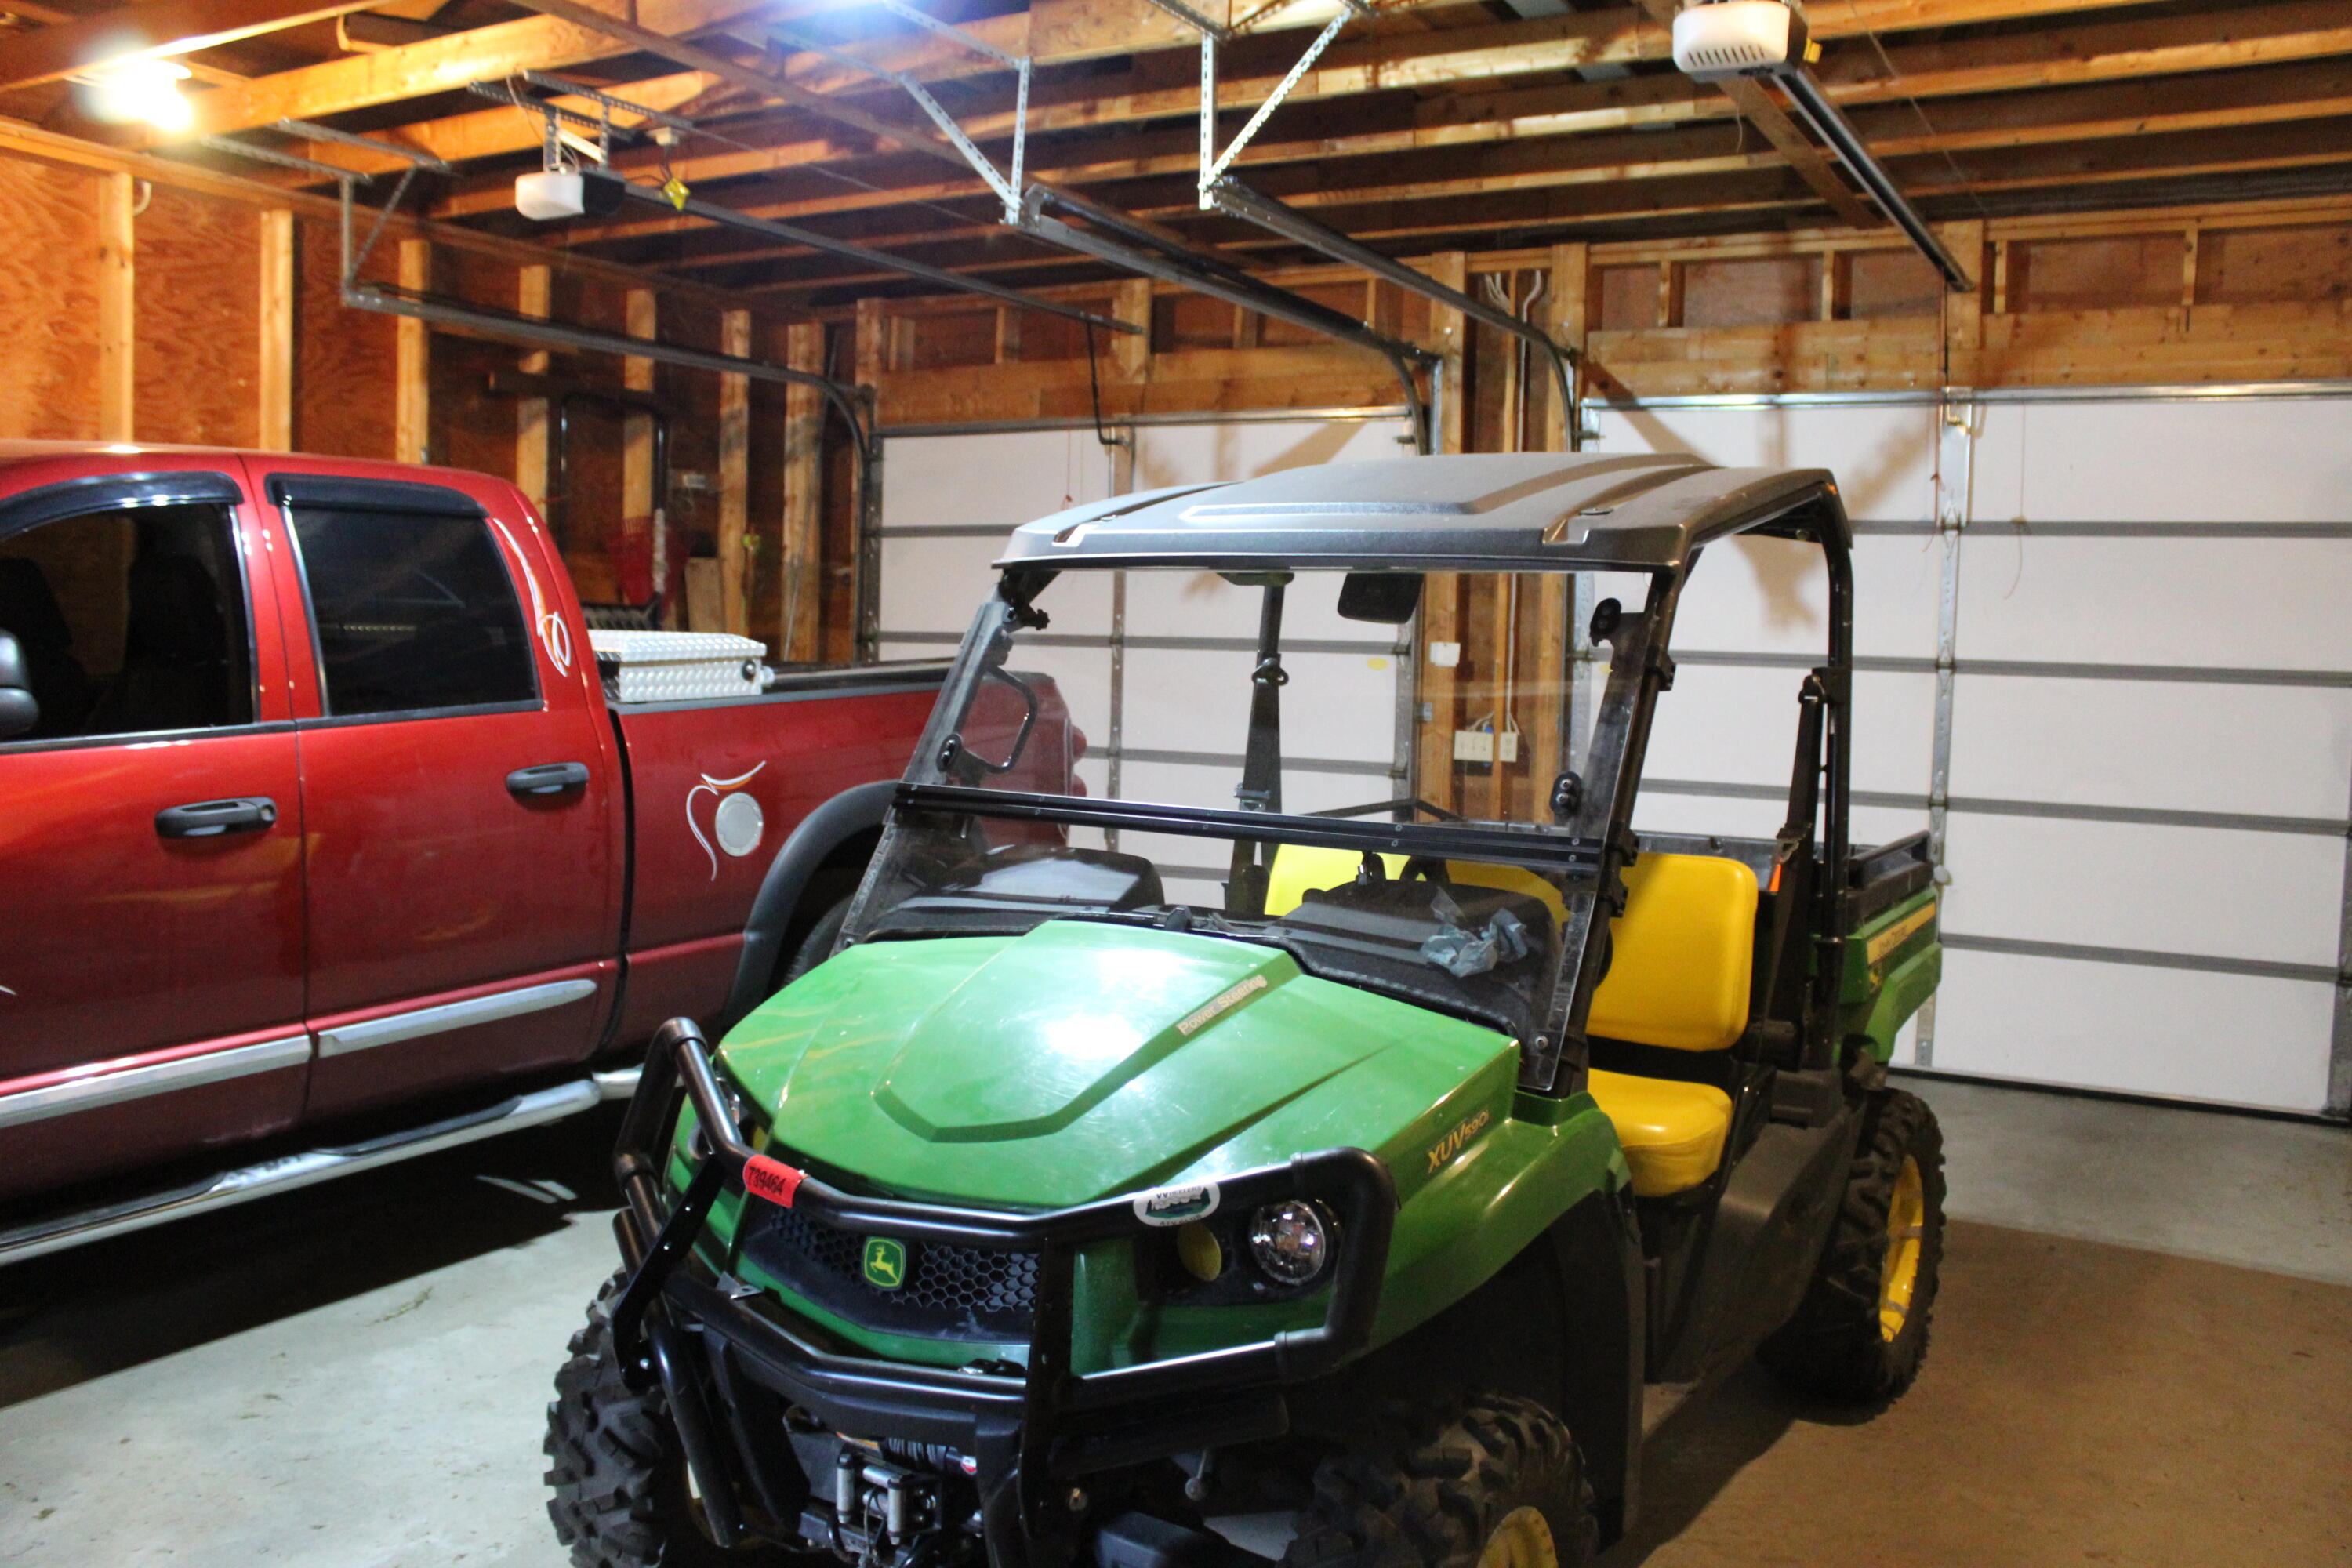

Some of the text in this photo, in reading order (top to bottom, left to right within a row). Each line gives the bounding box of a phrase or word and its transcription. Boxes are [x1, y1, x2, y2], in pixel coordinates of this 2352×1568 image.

[1178, 976, 1266, 1035] Power Steering
[749, 1166, 786, 1196] 739464
